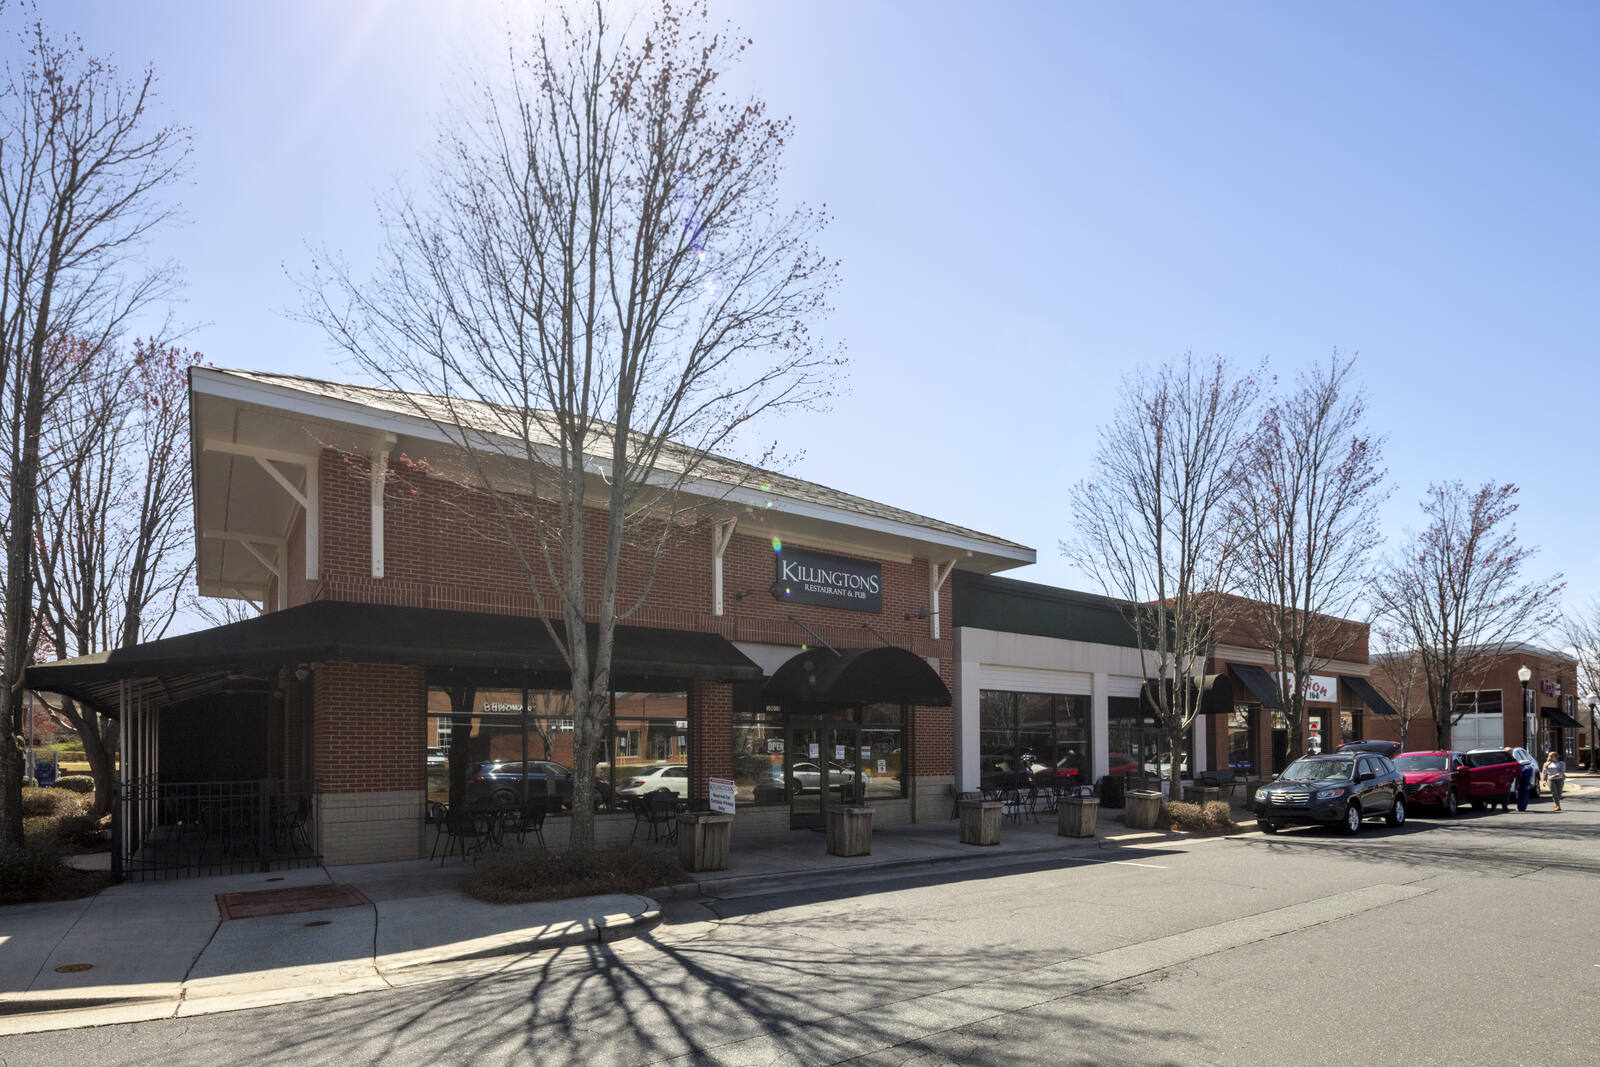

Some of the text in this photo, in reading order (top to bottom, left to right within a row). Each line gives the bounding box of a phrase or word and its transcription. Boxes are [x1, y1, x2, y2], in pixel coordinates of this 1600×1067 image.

[782, 560, 879, 594] KILLINGTONS
[805, 584, 846, 596] RESTAURANT
[855, 591, 866, 599] PUB
